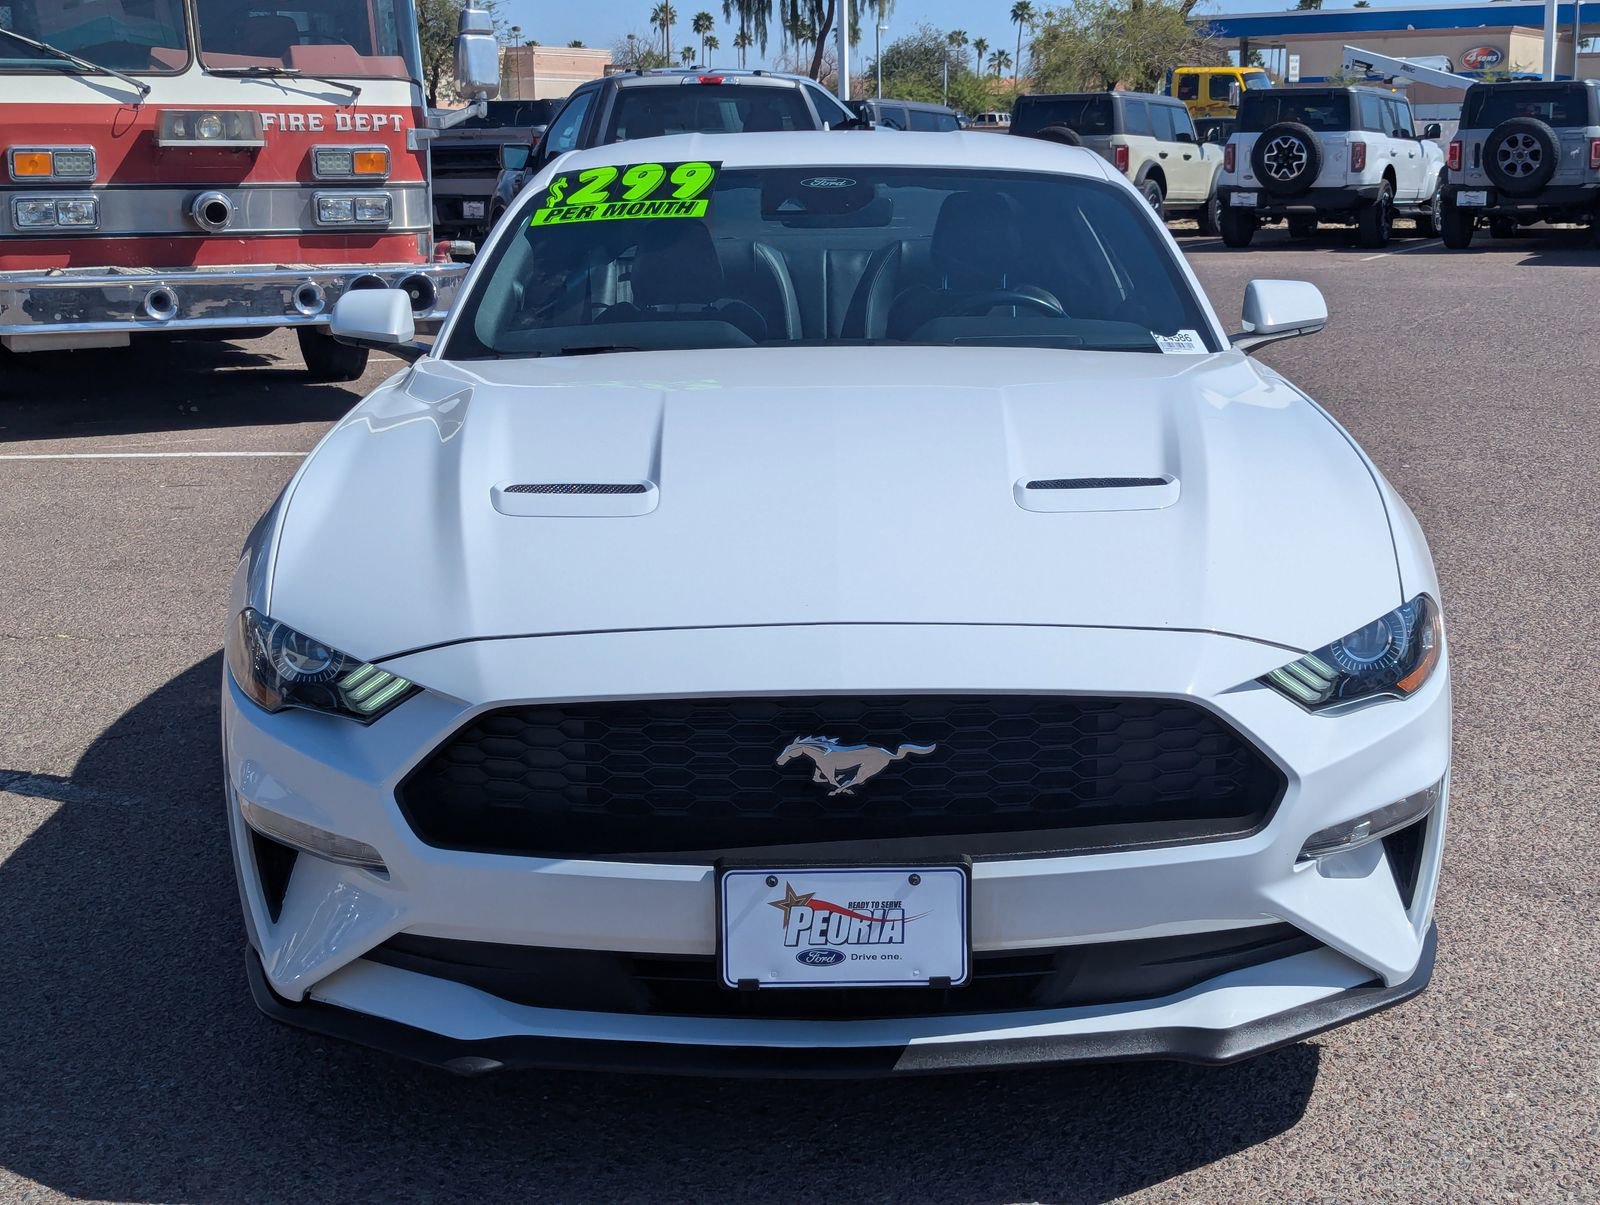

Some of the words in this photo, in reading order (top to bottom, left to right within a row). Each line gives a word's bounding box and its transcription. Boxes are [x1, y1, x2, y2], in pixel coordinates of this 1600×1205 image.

[1465, 52, 1477, 63] 4
[260, 112, 324, 131] FIRE
[334, 112, 404, 132] DEPT
[546, 162, 716, 208] $299
[543, 205, 598, 223] PER
[600, 200, 699, 217] MONTH
[848, 901, 869, 909] READY
[871, 901, 880, 909] TO
[881, 901, 902, 909] SERVE
[784, 905, 905, 947] PEORIA
[805, 951, 837, 963] Ford
[851, 953, 878, 961] Drive
